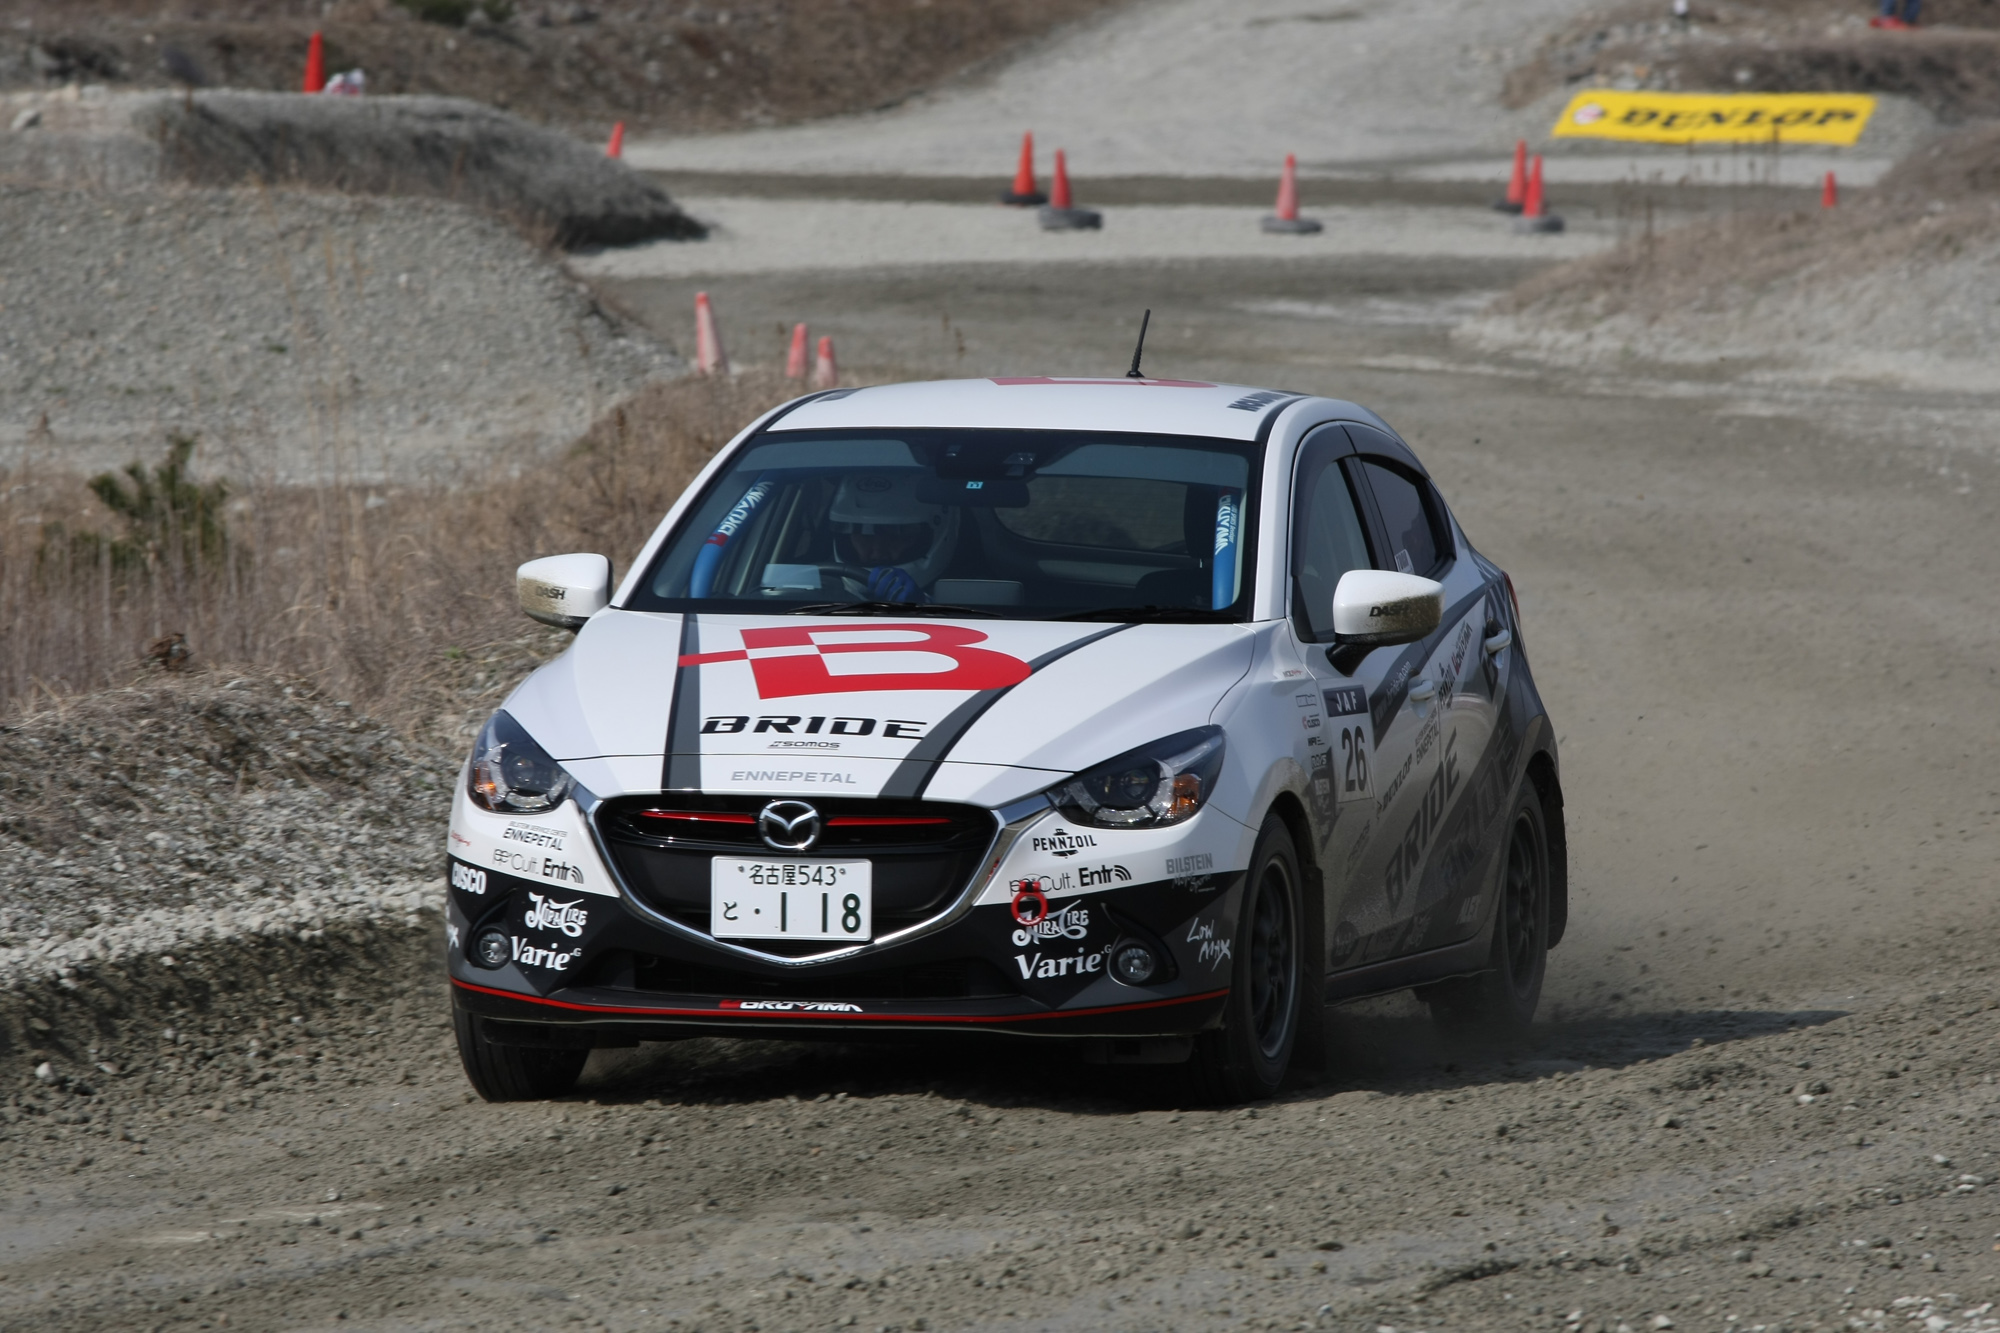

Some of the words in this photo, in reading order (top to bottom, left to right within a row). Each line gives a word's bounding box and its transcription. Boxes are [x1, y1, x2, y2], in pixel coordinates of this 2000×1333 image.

[1613, 108, 1858, 131] DUNLOP
[1336, 690, 1358, 713] JAF
[700, 715, 928, 741] BRIDE
[1341, 725, 1369, 793] 26
[731, 770, 857, 785] ENNEPETAL
[502, 827, 563, 851] ENNEPETAL
[1033, 834, 1098, 851] PENNZOIL
[1165, 853, 1214, 875] BILSTEIN
